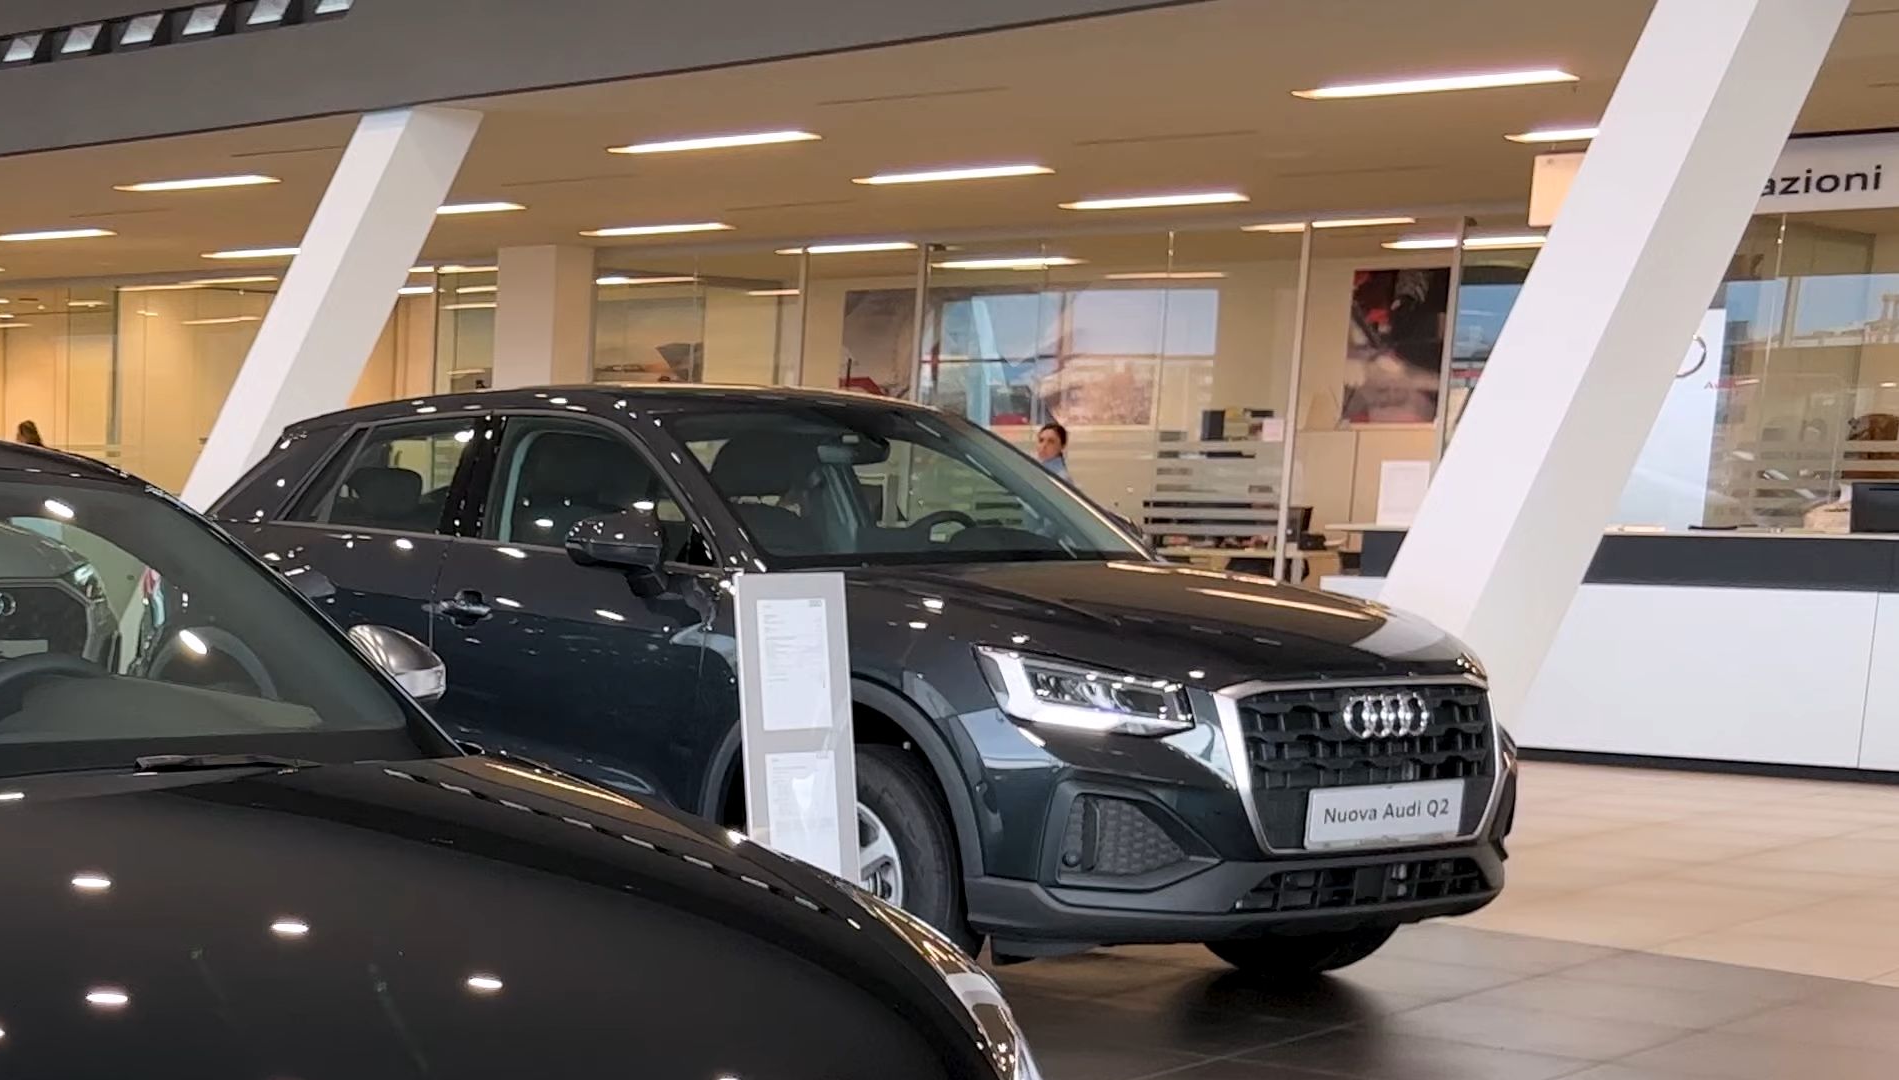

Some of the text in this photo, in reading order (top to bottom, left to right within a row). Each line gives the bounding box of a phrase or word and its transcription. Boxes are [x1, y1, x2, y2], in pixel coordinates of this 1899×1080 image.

[1323, 798, 1449, 825] Nuova Audi Q2
